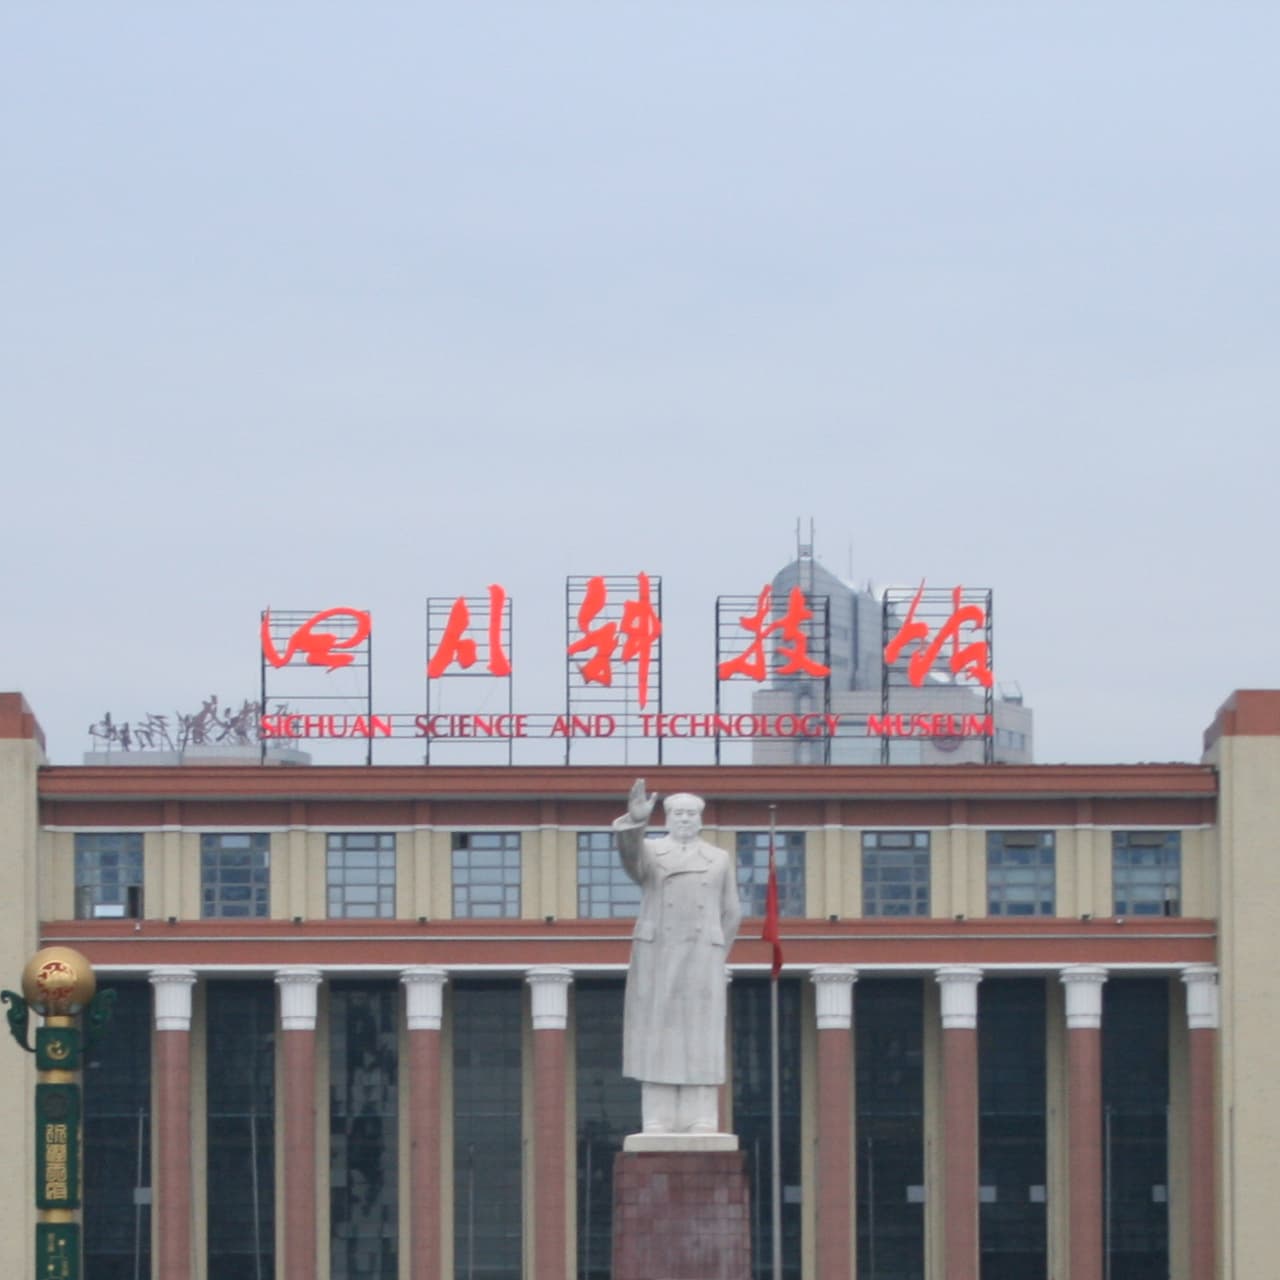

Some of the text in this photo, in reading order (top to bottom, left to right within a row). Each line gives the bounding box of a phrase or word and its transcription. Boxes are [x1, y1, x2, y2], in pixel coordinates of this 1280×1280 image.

[260, 571, 995, 709] 四川科技馆
[260, 713, 393, 738] SICHUAN
[414, 713, 528, 738] SCIENCE
[550, 713, 616, 738] AND
[640, 713, 840, 738] TECHNOLOGY
[867, 713, 995, 738] MUSEUM
